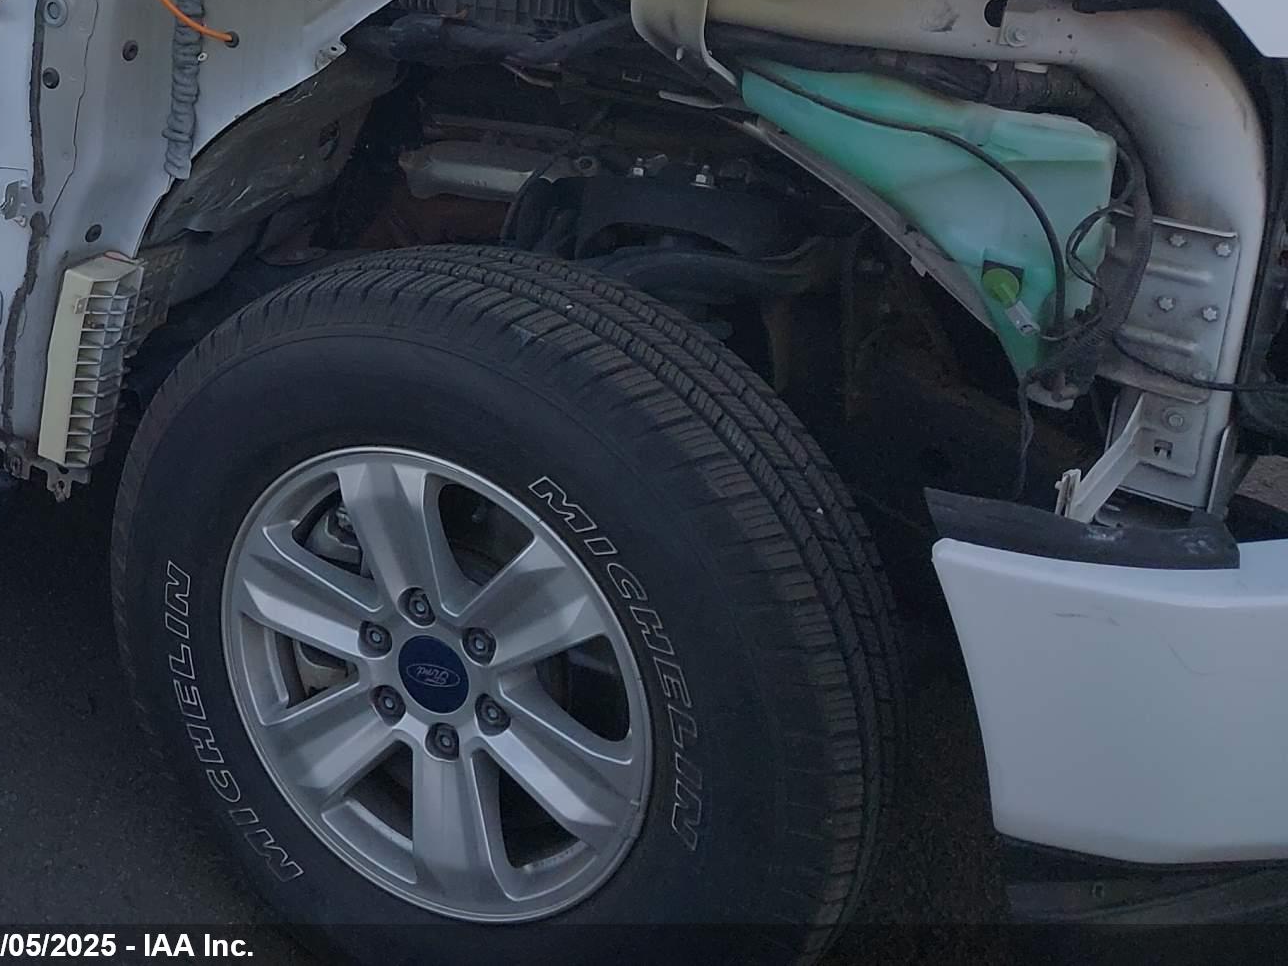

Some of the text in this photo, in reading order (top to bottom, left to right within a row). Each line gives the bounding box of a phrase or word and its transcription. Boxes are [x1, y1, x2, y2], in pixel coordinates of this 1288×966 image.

[165, 560, 304, 882] MICHELIN
[414, 665, 450, 685] Ford
[528, 475, 702, 851] MICHELIN
